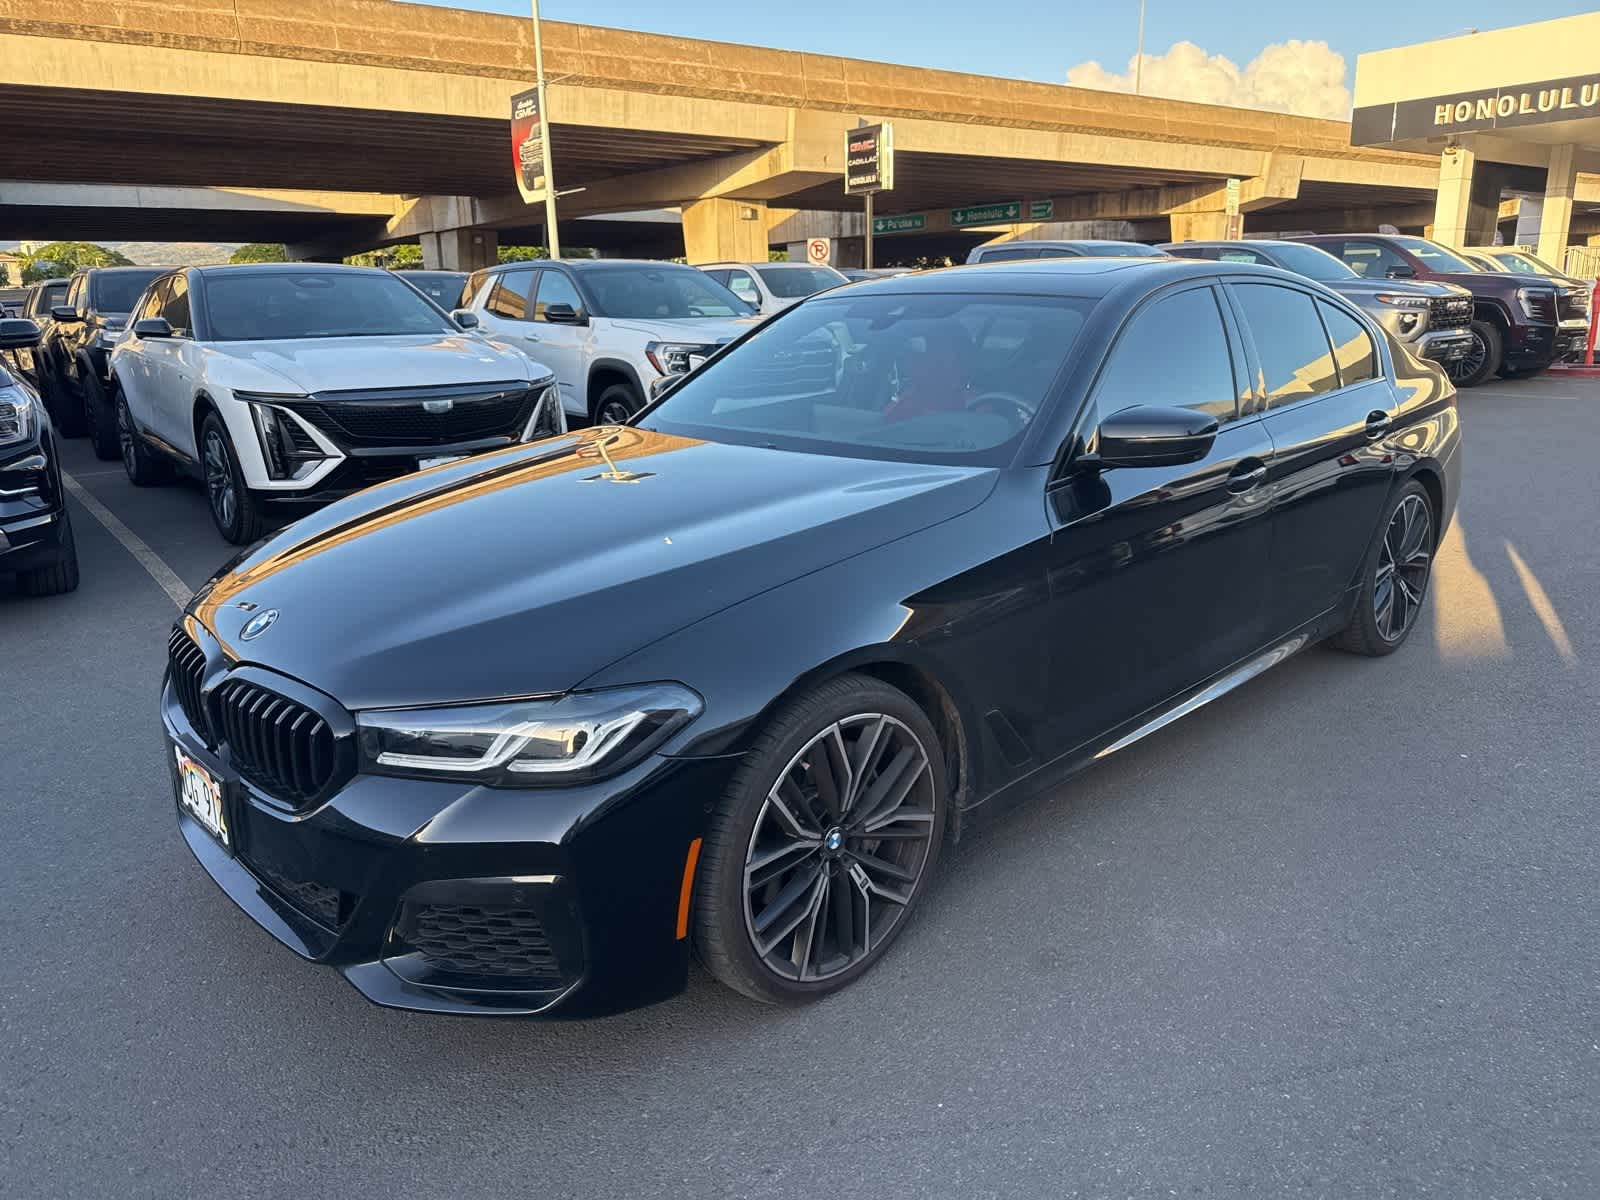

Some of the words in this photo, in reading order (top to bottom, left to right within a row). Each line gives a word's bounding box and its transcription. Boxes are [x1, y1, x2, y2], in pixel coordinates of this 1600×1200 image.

[1434, 83, 1600, 125] HONOLULU
[514, 104, 537, 120] GMC
[850, 139, 875, 152] GMC
[848, 156, 877, 167] CADILLAC
[967, 207, 1003, 221] Honolulu
